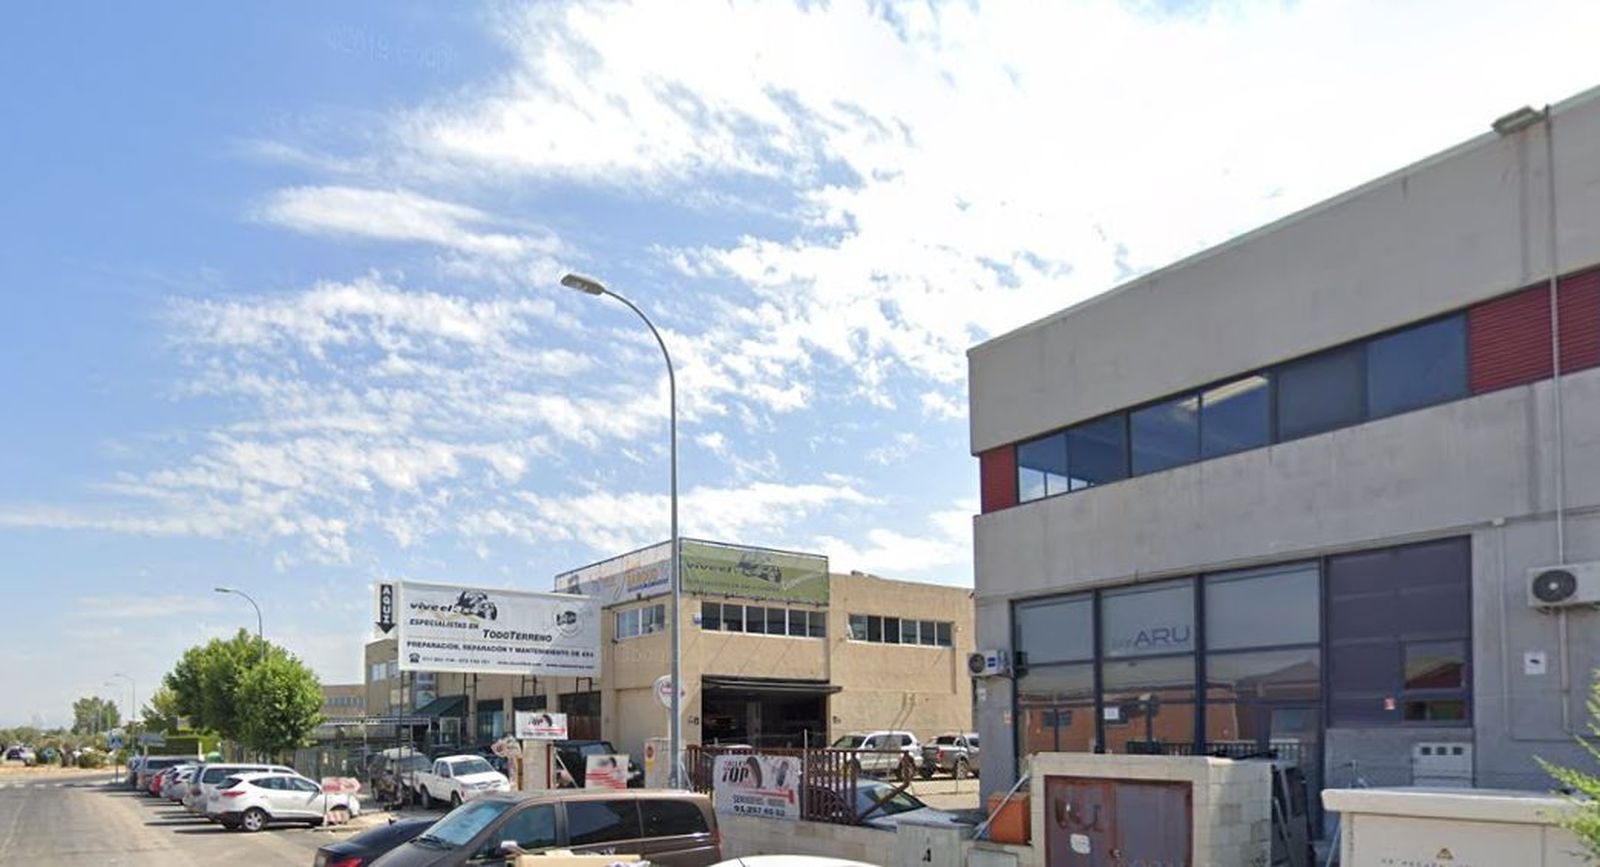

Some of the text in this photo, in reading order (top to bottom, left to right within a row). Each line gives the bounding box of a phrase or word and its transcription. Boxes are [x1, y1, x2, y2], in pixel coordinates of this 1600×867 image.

[410, 602, 438, 611] vive
[410, 619, 467, 628] ESPECIALISTAS
[1134, 625, 1190, 648] ARU
[515, 648, 569, 656] MANTENIMIENTO
[722, 767, 749, 782] TOP
